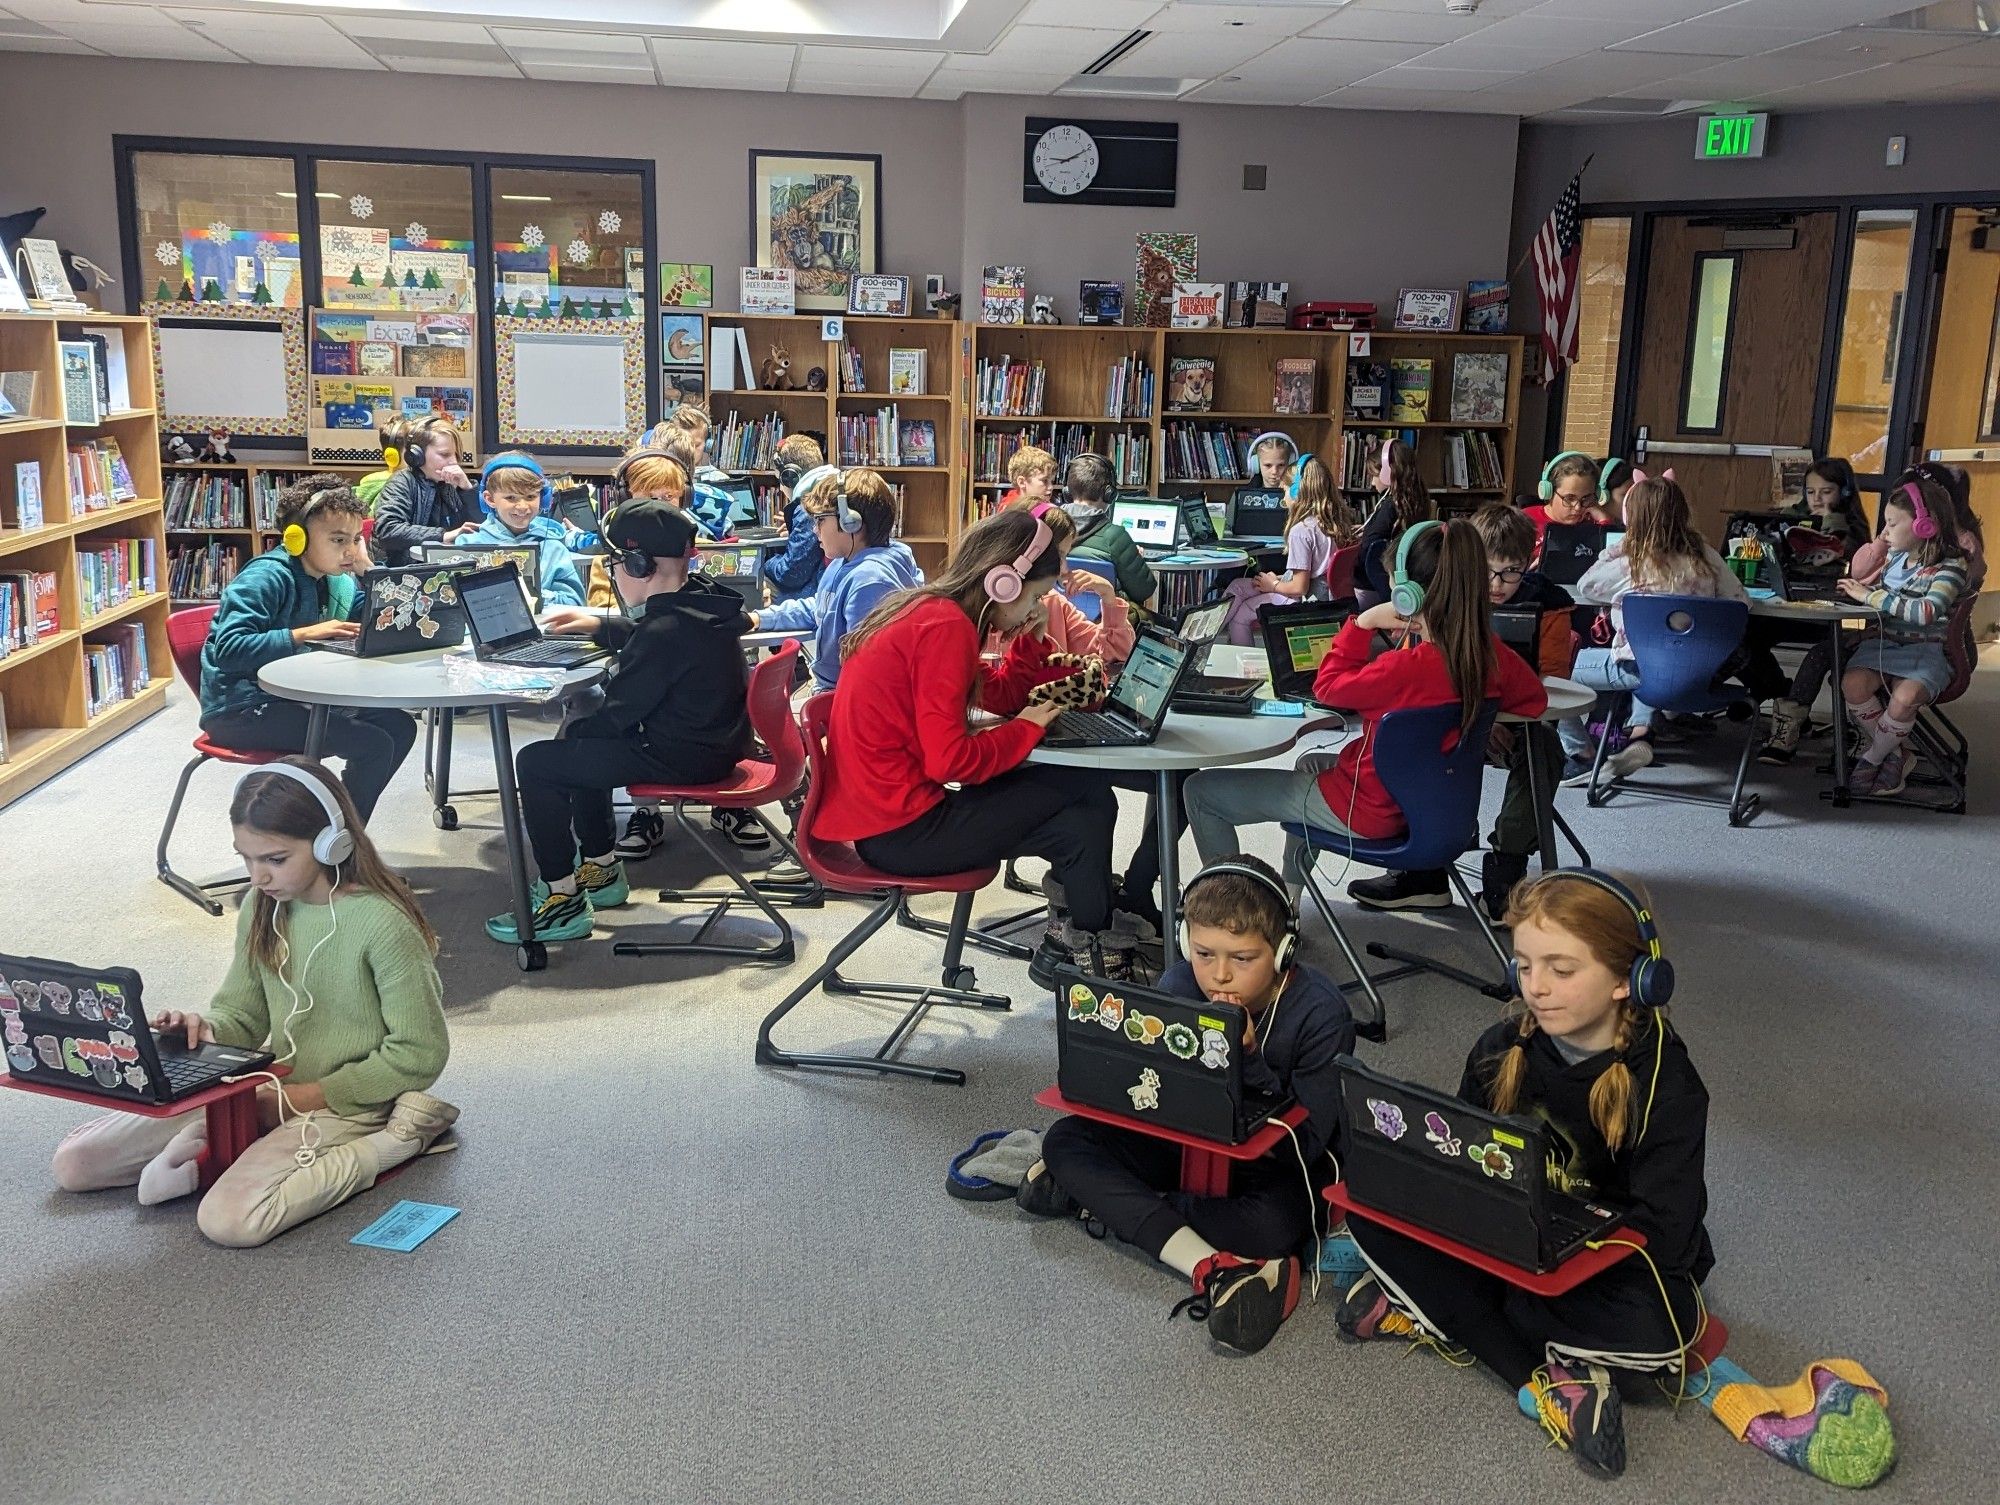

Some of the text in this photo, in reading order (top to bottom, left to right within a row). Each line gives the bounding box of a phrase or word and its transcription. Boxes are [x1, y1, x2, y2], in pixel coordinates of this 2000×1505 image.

[1062, 128, 1071, 136] 12
[1705, 117, 1755, 156] EXIT
[1039, 170, 1044, 178] 8
[862, 279, 898, 287] 600-699
[986, 287, 1021, 297] BICYCLES
[1180, 297, 1217, 306] HERMIT
[1412, 293, 1446, 302] 700-799
[1180, 305, 1216, 315] CRABS
[826, 320, 839, 336] 6
[374, 326, 417, 341] EXTRA
[1353, 336, 1366, 352] 7
[1176, 359, 1211, 370] Chiweenie
[1284, 362, 1312, 370] POODLES
